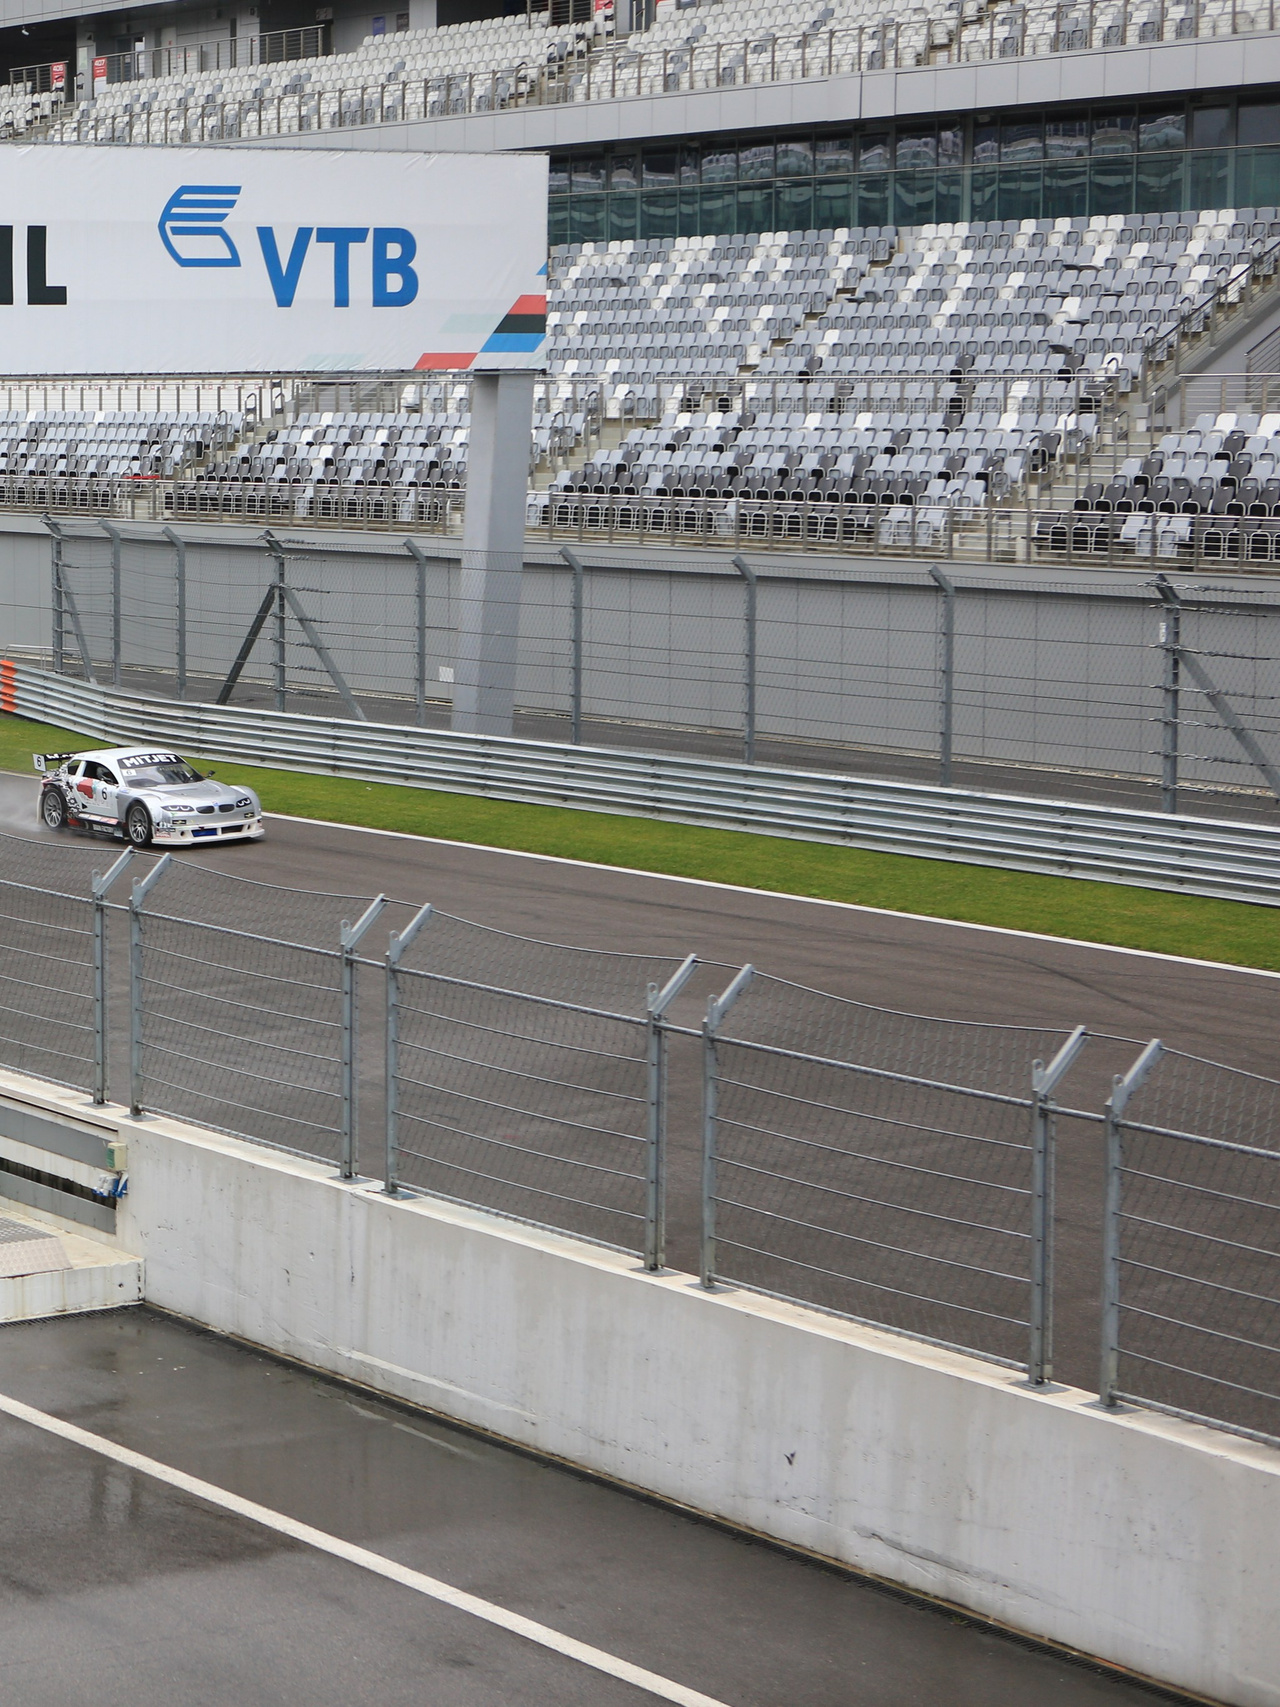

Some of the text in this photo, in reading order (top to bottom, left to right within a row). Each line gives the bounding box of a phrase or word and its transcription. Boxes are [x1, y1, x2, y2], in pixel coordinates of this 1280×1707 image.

[256, 226, 419, 308] VTB
[37, 756, 41, 767] 6
[122, 754, 177, 767] MITJET
[102, 787, 107, 800] 6
